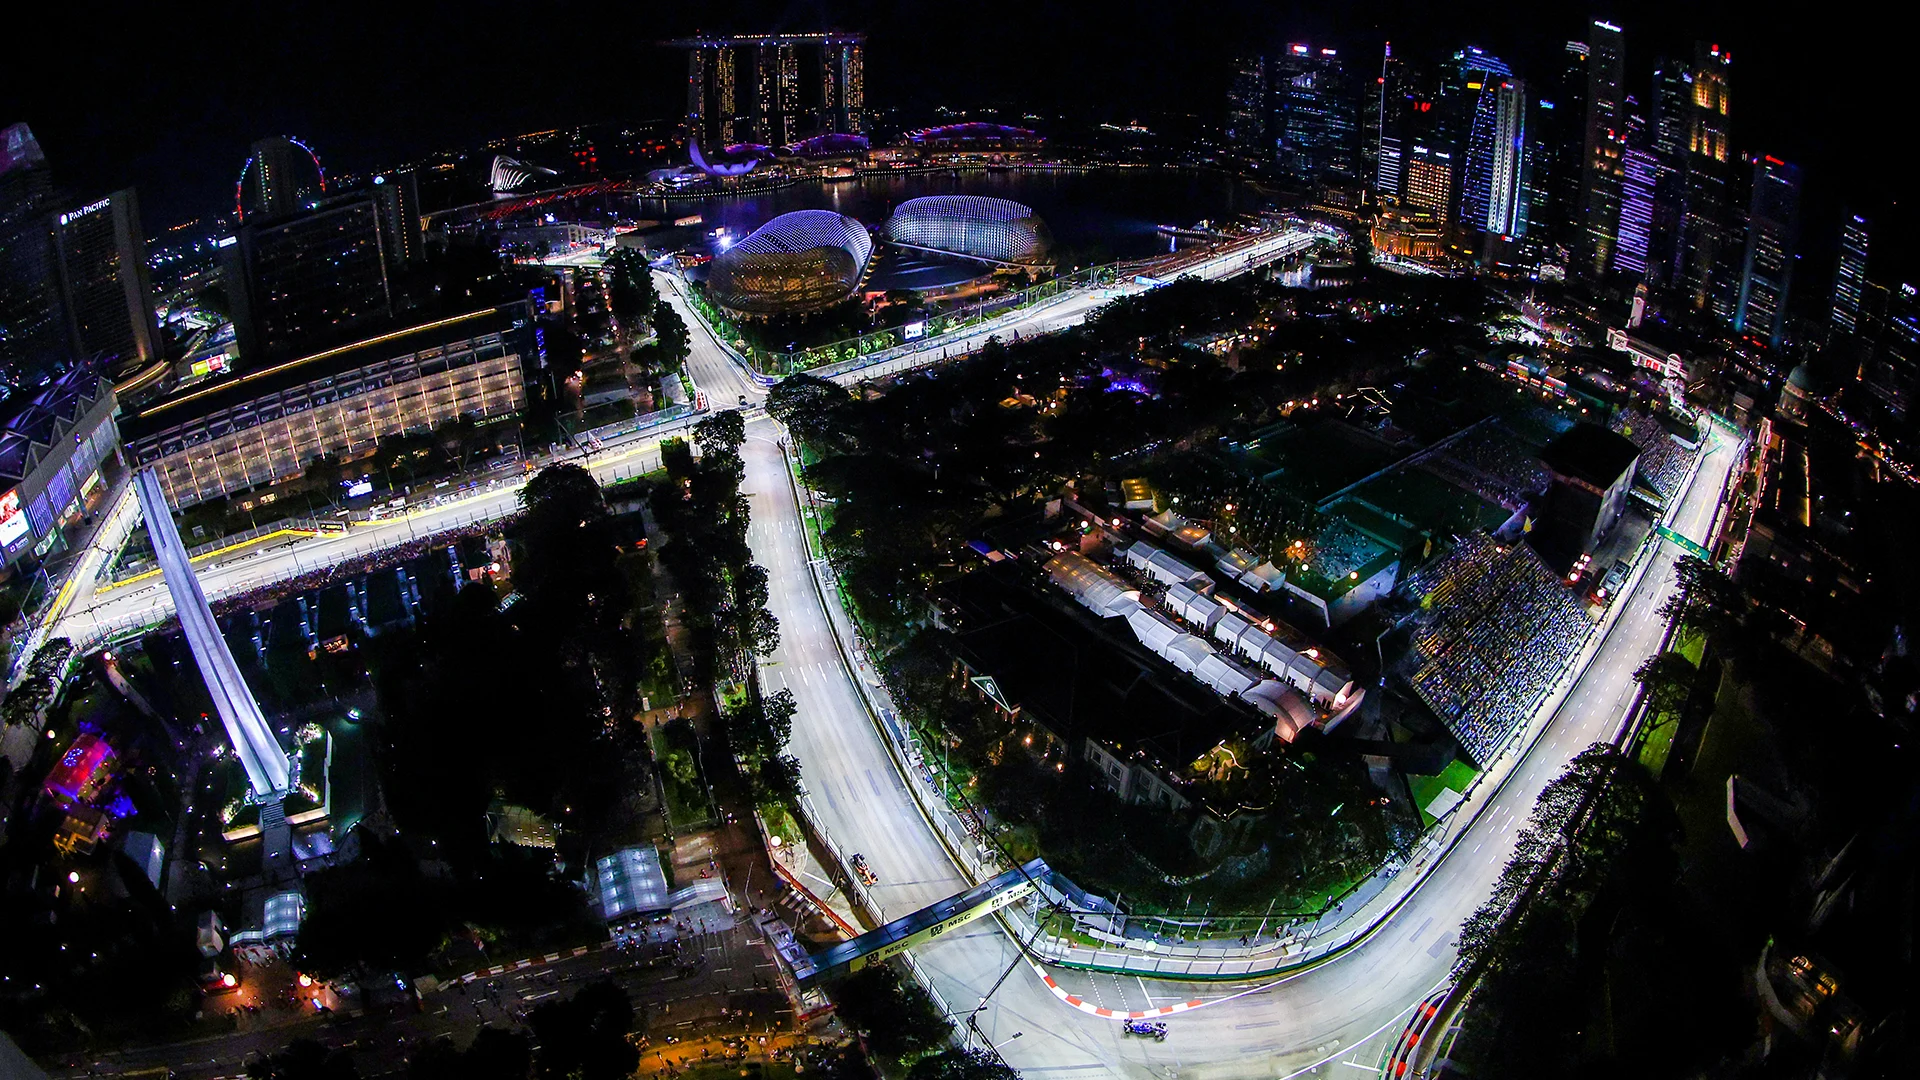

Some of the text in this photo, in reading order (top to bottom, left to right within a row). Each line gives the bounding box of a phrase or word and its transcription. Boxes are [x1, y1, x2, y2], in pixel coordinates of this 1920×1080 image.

[68, 198, 110, 221] PAN PACIFIC
[1008, 886, 1029, 900] MSC
[947, 913, 971, 928] MSC
[884, 941, 908, 955] MSC
